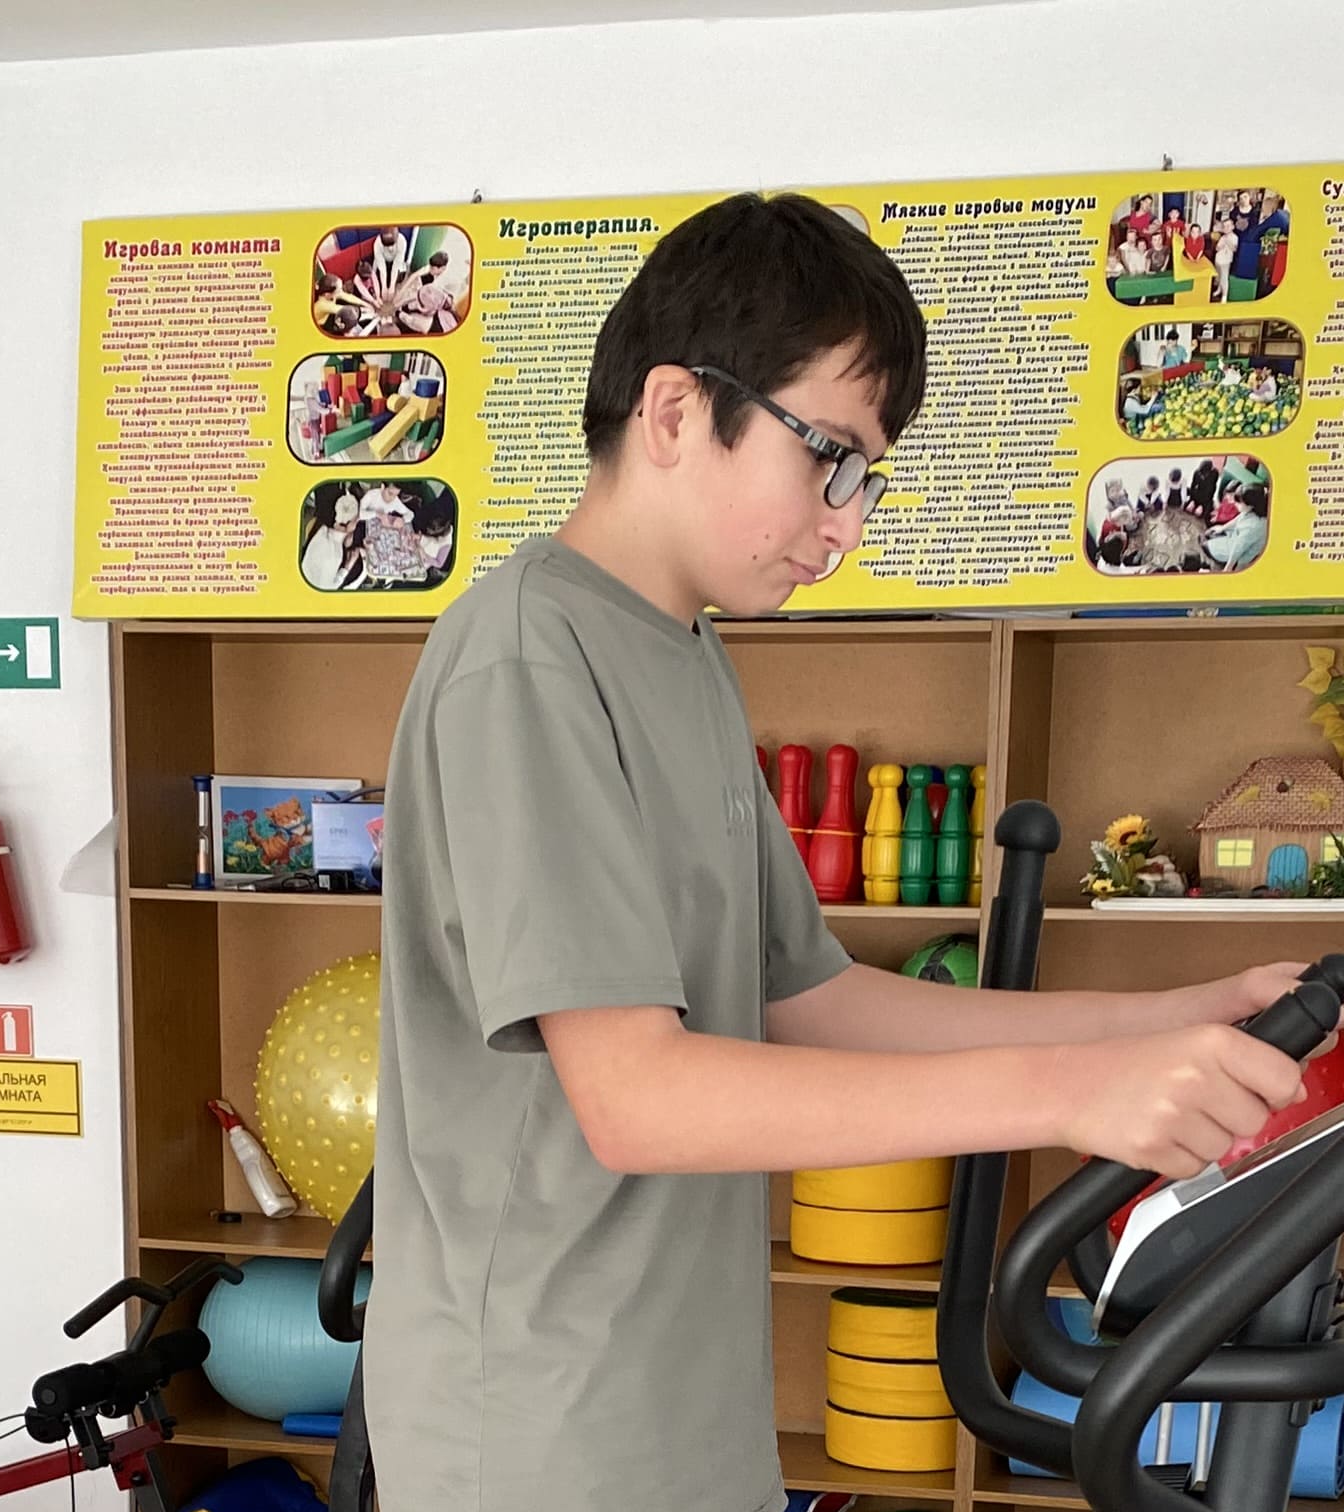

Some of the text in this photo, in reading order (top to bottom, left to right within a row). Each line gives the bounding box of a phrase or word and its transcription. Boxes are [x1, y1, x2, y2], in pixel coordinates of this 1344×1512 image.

[882, 197, 1096, 223] Мягкие игровые модули
[499, 218, 659, 240] Игротерапия.
[104, 239, 280, 261] Игровая комната
